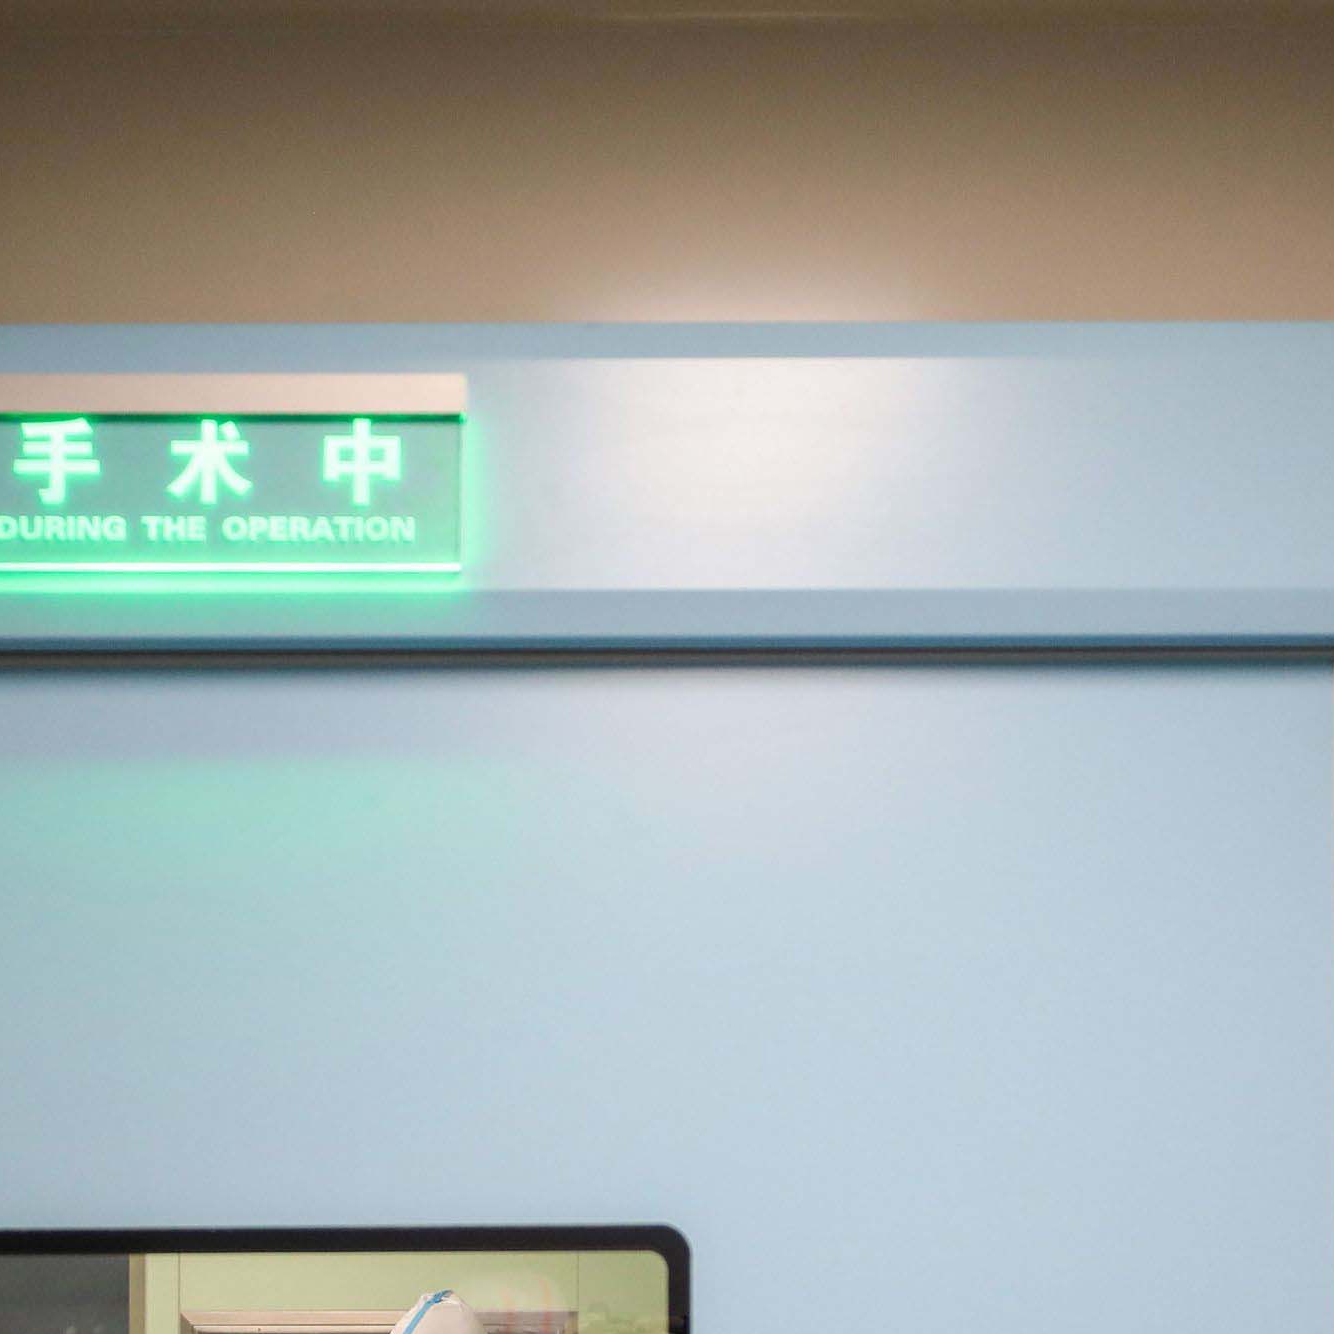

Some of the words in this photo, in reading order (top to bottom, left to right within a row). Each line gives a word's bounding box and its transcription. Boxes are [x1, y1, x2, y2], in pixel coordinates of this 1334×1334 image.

[13, 418, 402, 505] 手术中
[141, 515, 207, 542] THE
[223, 515, 416, 542] OPERATION
